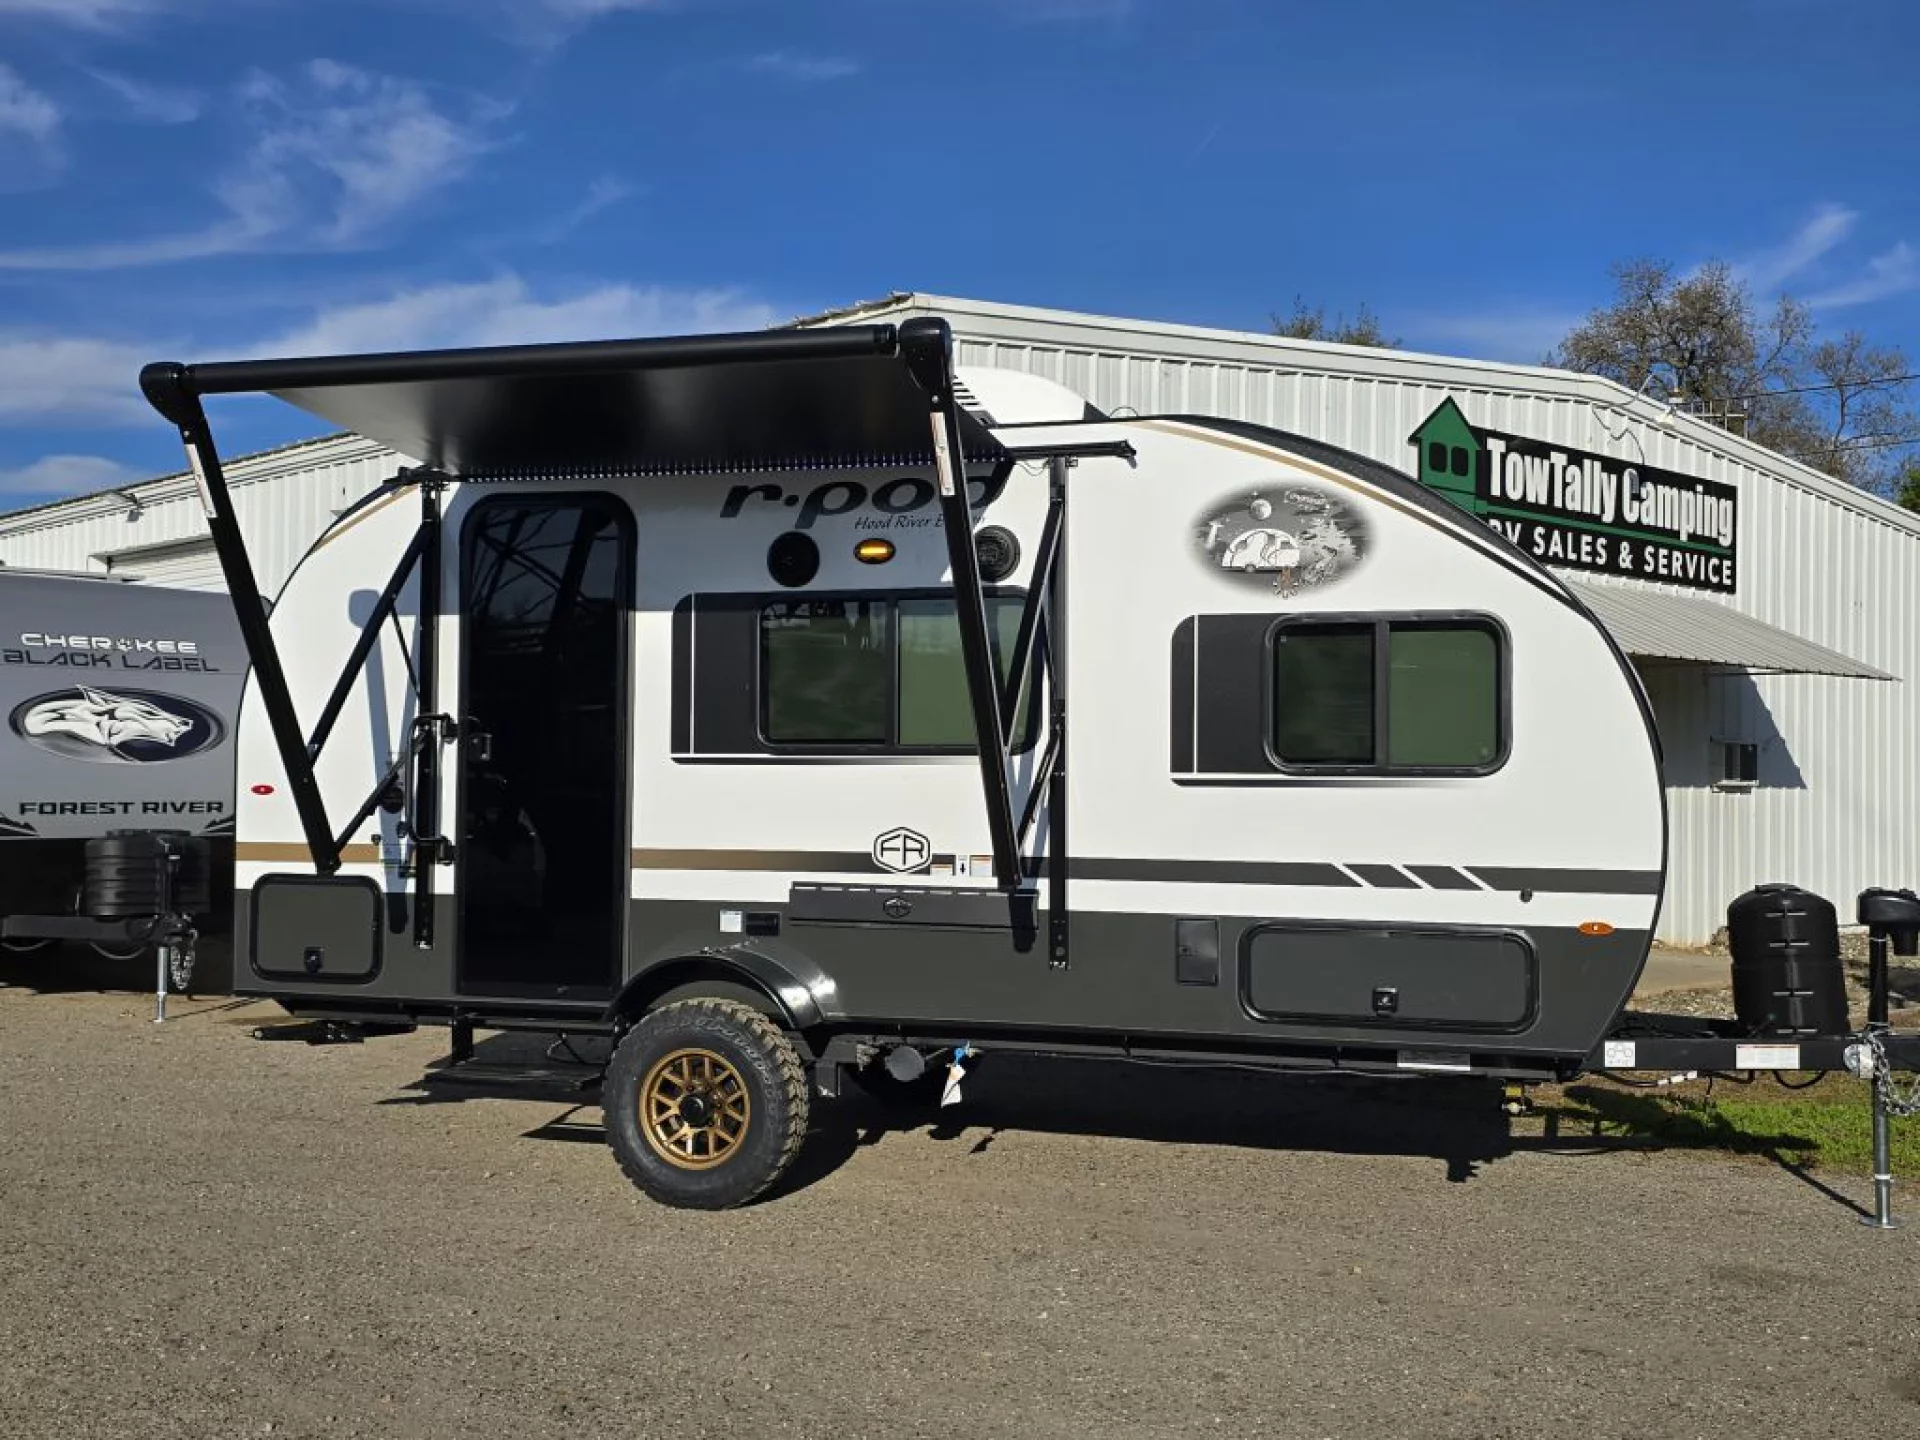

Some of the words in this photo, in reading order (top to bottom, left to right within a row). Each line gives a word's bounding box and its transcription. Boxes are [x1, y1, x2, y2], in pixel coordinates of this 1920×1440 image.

[1486, 437, 1619, 524] TowTally
[1622, 468, 1734, 547] Camping
[854, 515, 892, 530] Hood
[894, 514, 931, 528] River
[1533, 526, 1609, 566] SALES
[1618, 541, 1635, 570] &
[1643, 546, 1733, 586] SERVICE
[3, 650, 112, 668] BLACK
[121, 655, 220, 672] LABEL
[20, 801, 136, 815] FOREST
[141, 801, 224, 814] RIVER
